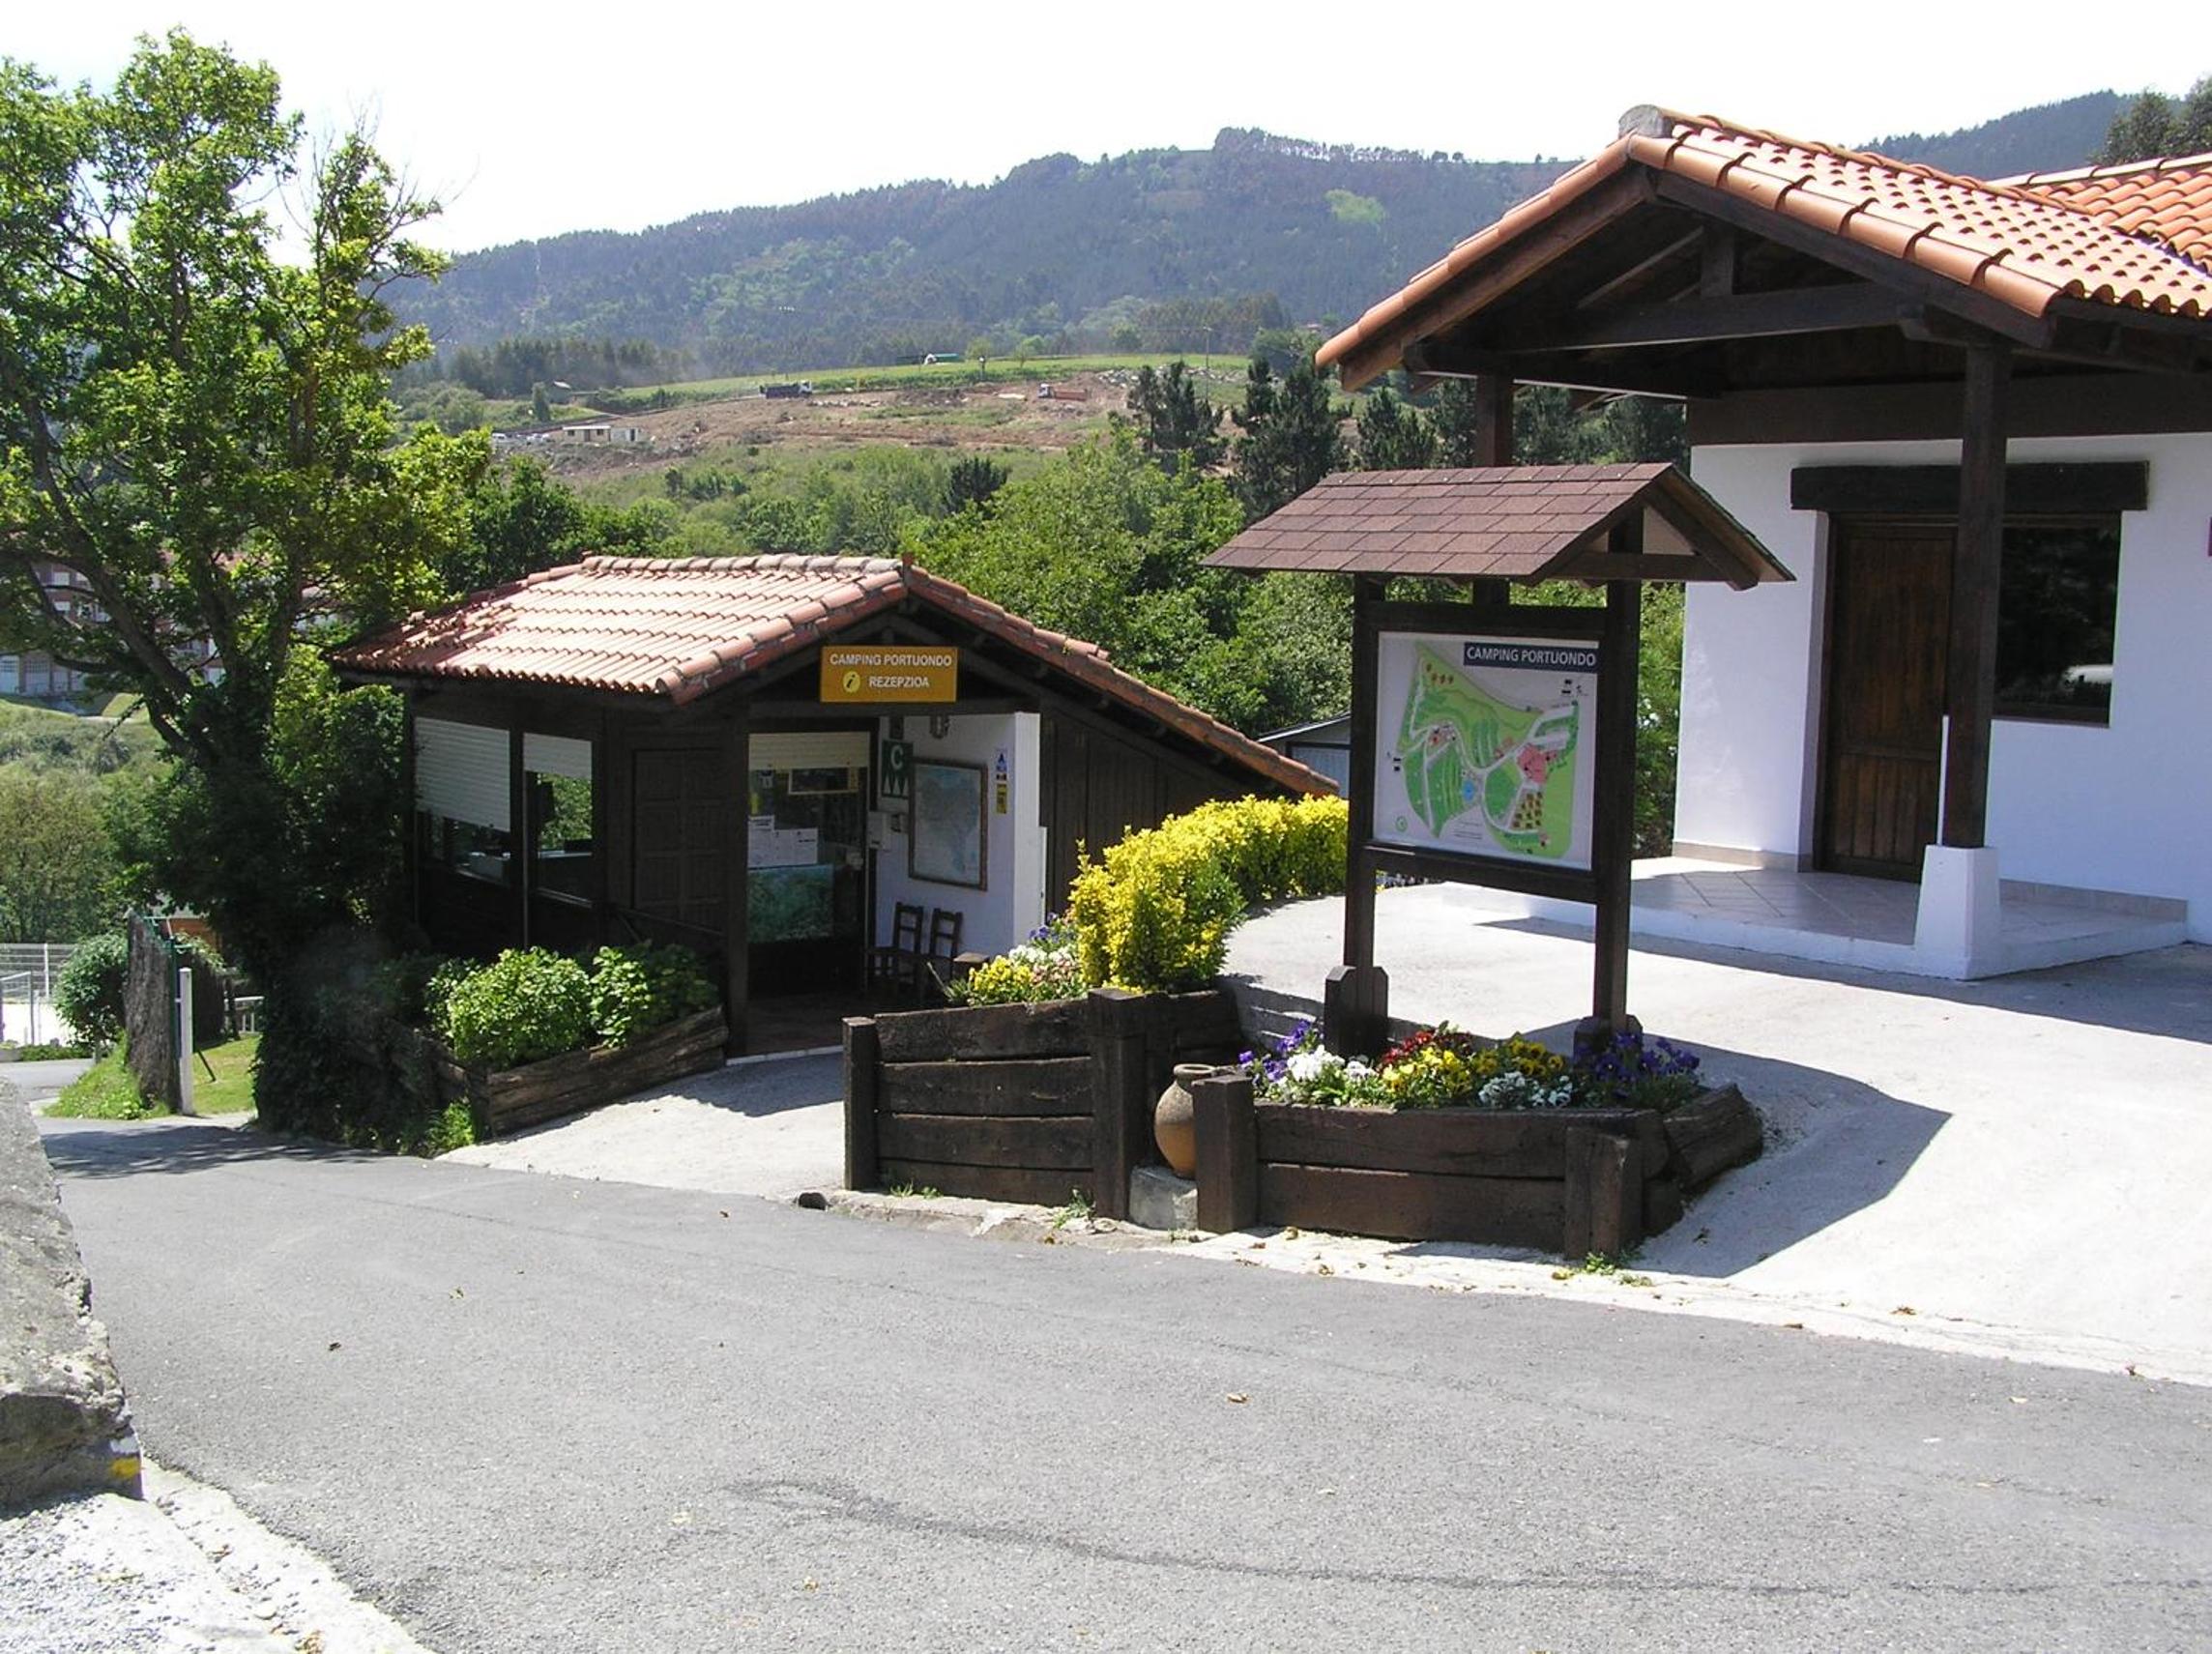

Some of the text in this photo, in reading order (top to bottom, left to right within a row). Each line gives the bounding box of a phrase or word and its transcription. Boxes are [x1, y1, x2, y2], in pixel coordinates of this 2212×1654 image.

[830, 653, 952, 667] CAMPING PORTUONDO
[1466, 646, 1596, 667] CAMPING PORTUONDO
[868, 676, 930, 688] REZEPZIOA
[890, 744, 904, 769] C
